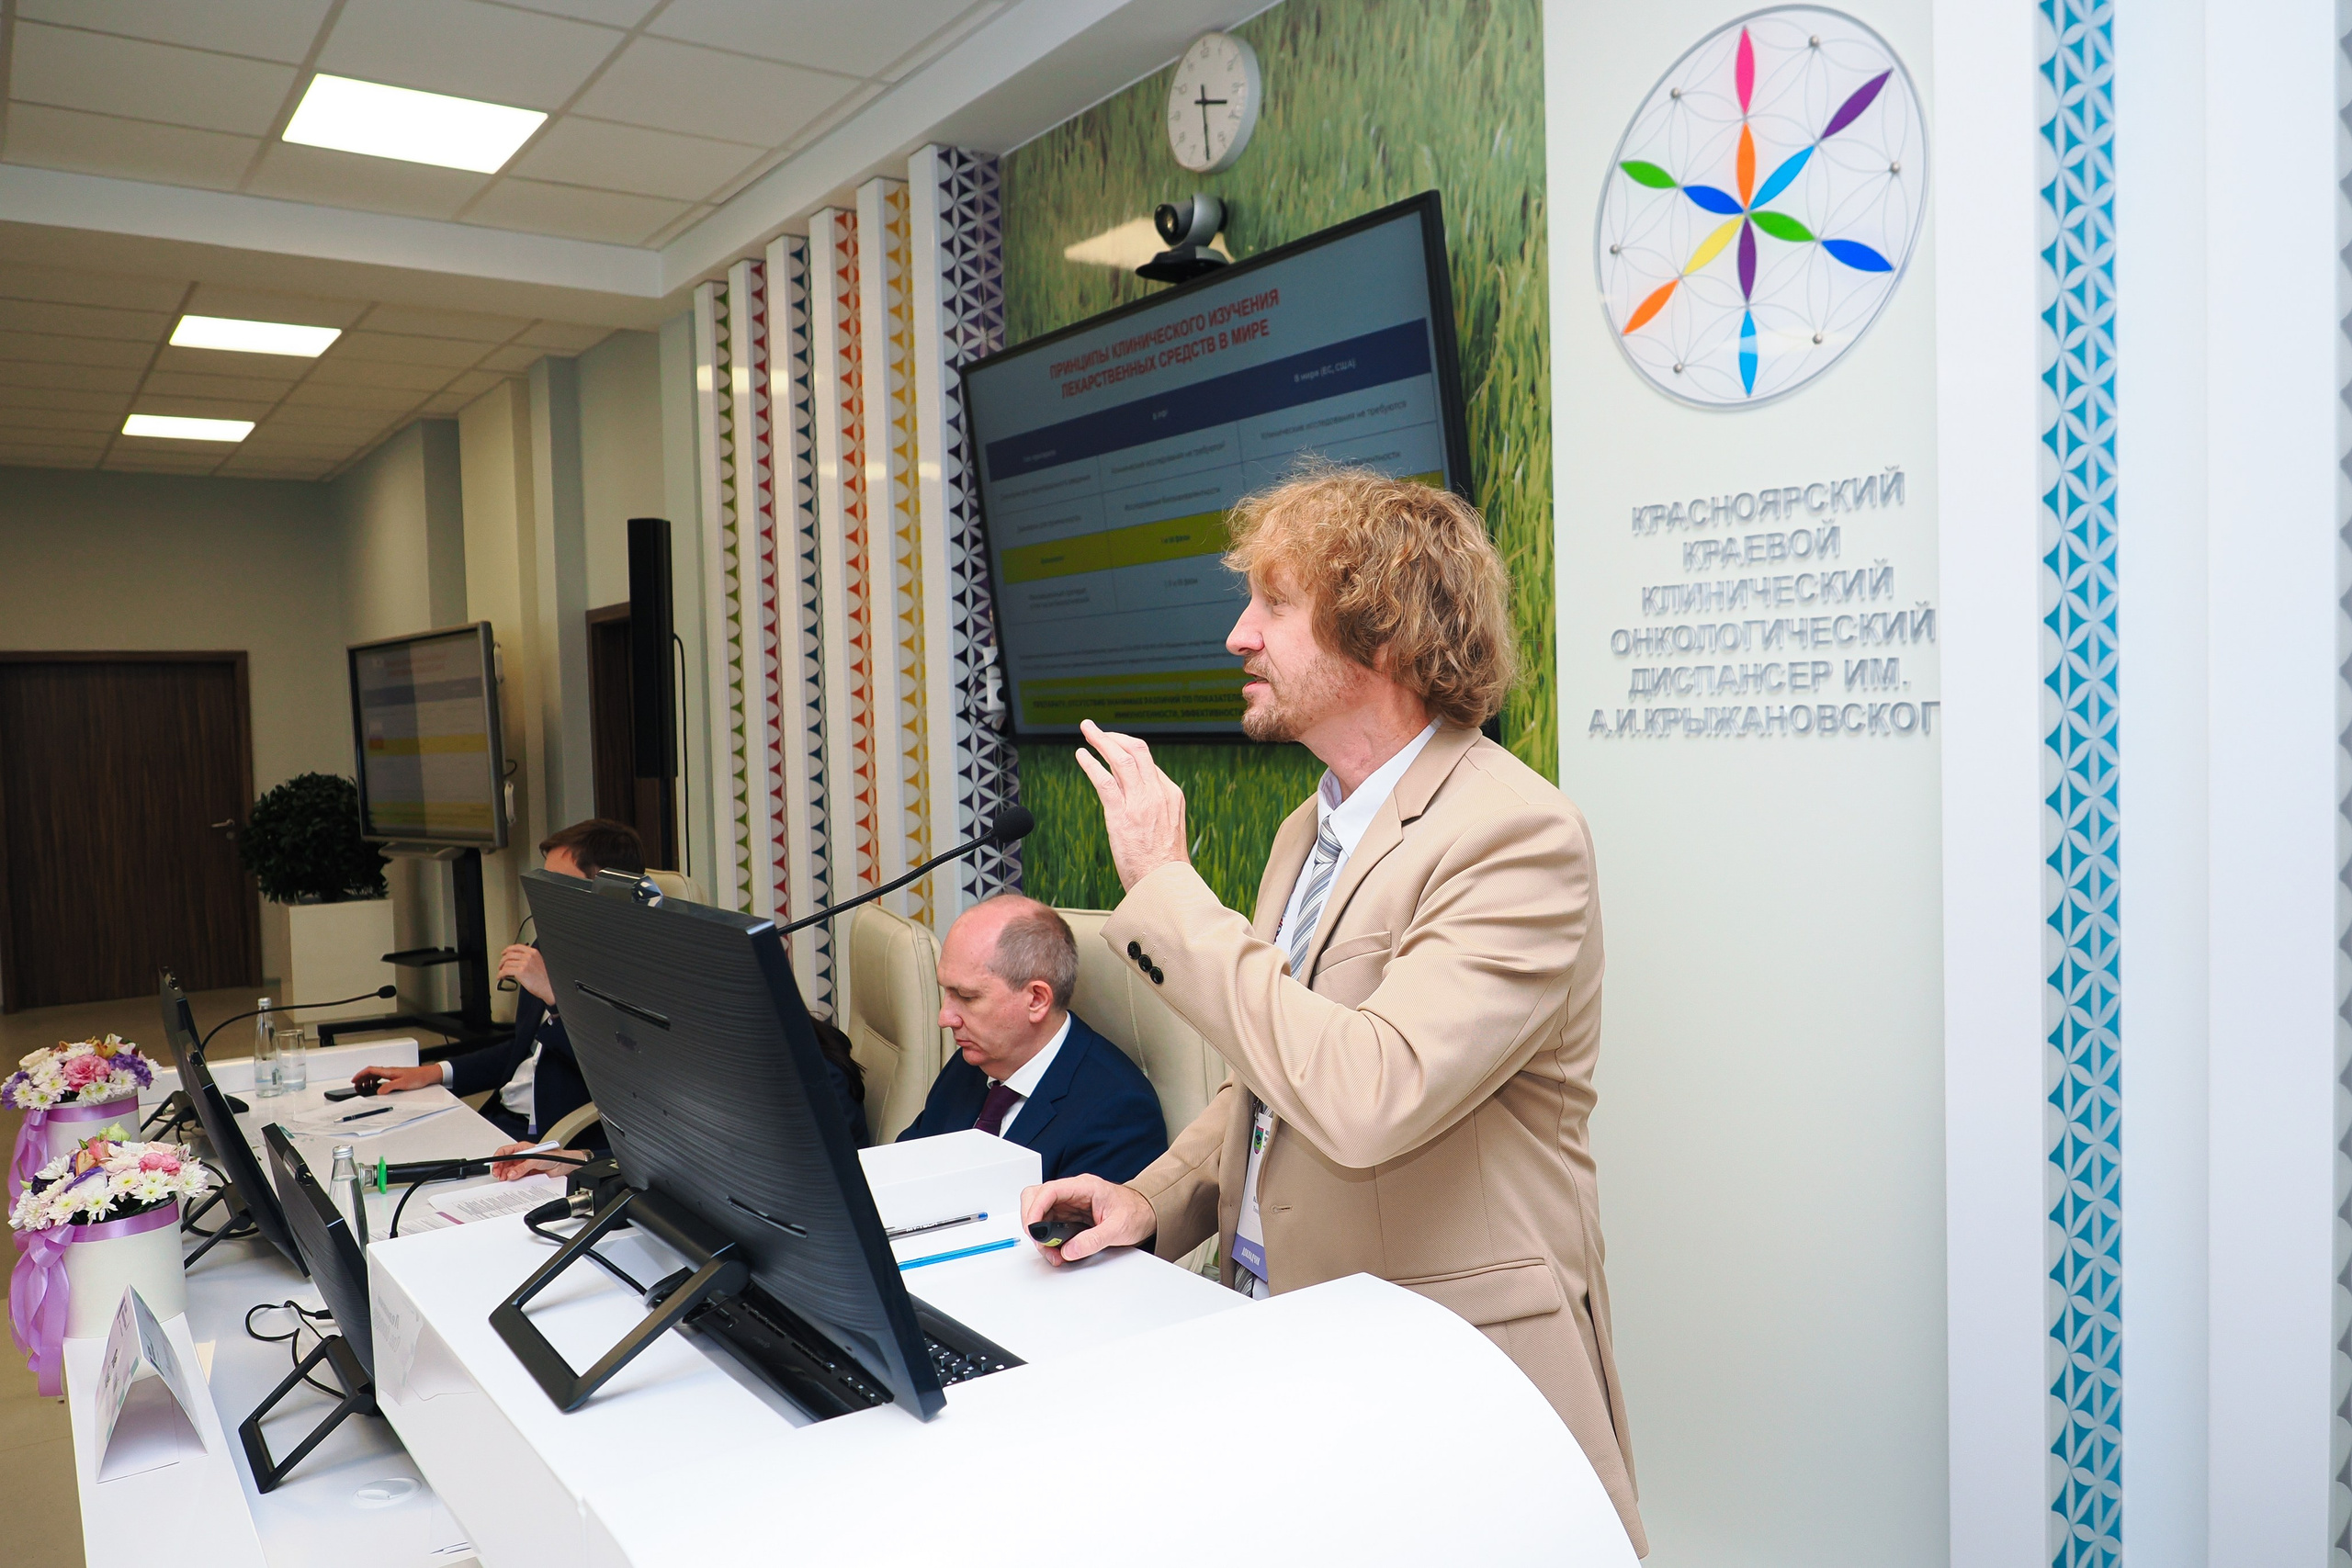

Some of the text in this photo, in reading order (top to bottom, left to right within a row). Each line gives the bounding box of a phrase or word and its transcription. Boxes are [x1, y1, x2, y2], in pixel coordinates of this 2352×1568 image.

[1049, 288, 1280, 380] ПРИНЦИПЫ КЛИНИЧЕСКОГО ИЗУЧЕНИЯ
[1061, 319, 1271, 399] ЛЕКАРСТВЕННЫХ СРЕДСТВ В МИРЕ
[1631, 464, 1905, 536] КРАСНОЯРСКИЙ
[1682, 517, 1840, 571] КРАЕВОЙ
[1641, 558, 1894, 615] КЛИНИЧЕСКИЙ
[1611, 600, 1937, 659] ОНКОЛОГИЧЕСКИЙ
[1628, 658, 1911, 702] ДИСПАНСЕР ИМ.
